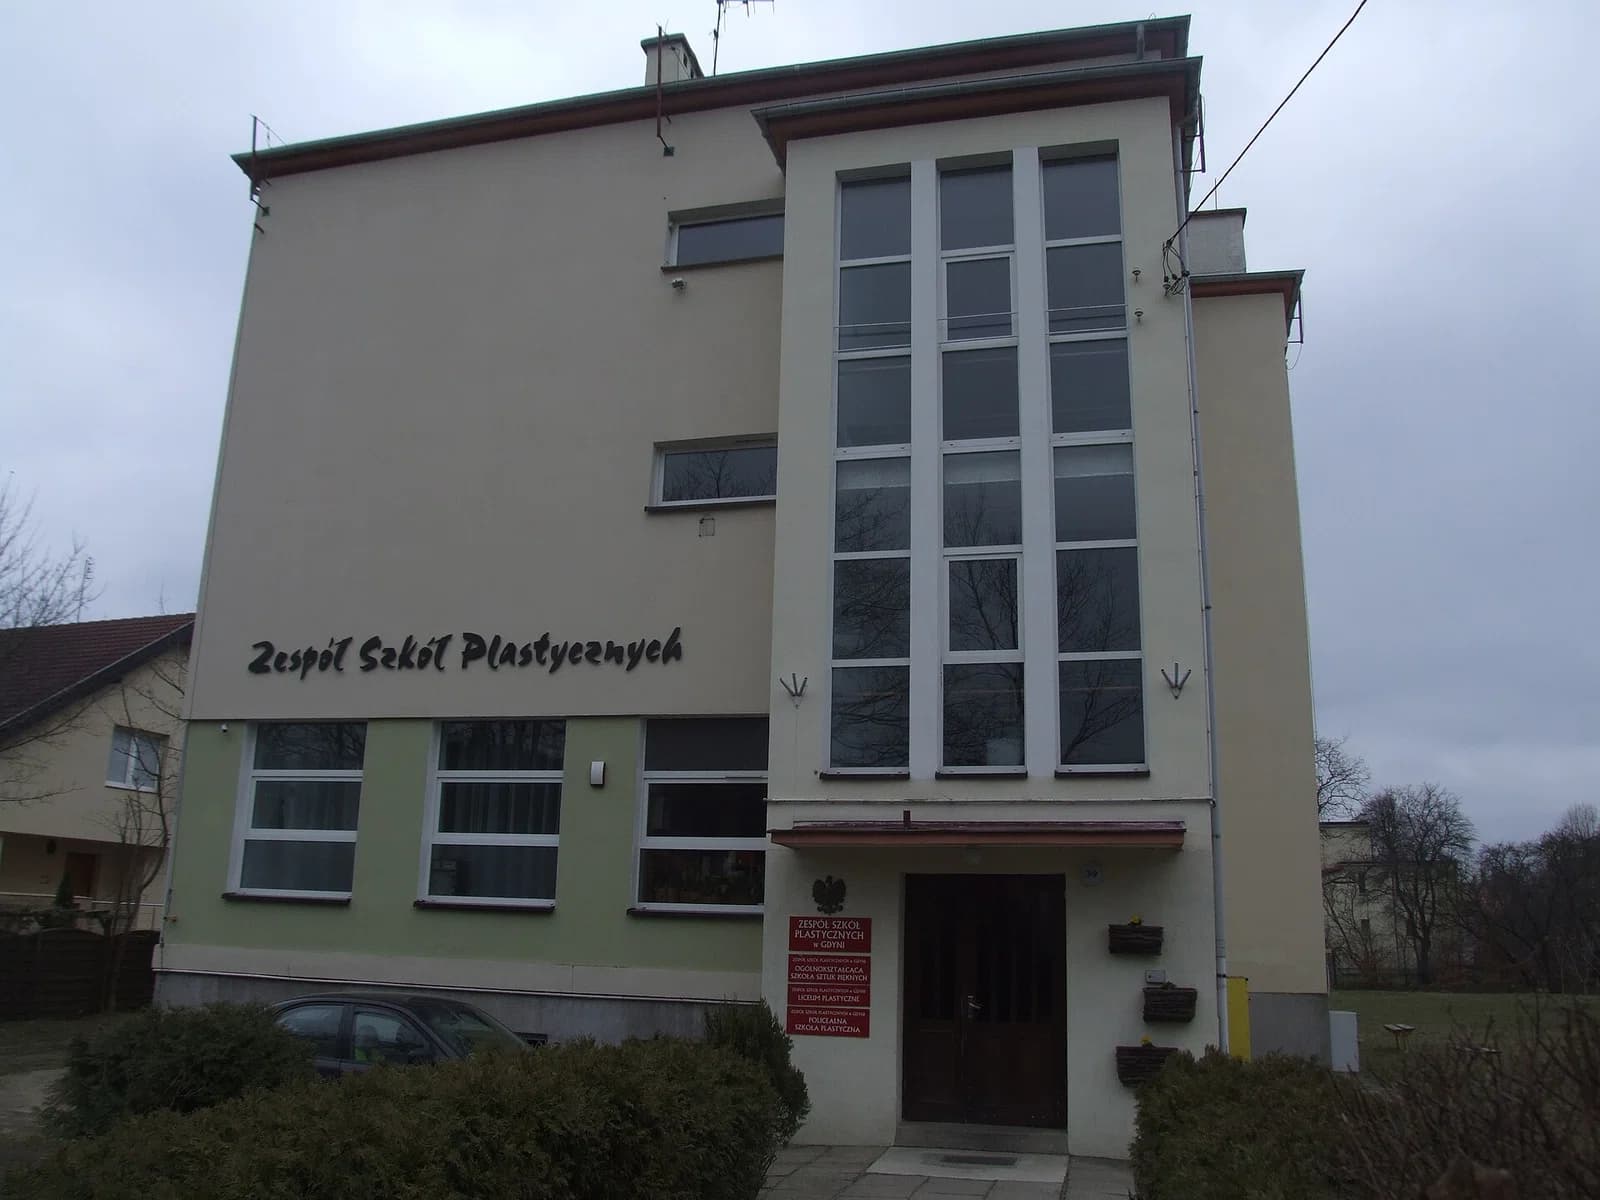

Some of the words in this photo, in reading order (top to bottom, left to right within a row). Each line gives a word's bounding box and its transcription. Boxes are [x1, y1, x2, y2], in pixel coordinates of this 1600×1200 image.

[248, 636, 353, 681] Zespół
[360, 634, 453, 672] Szkół
[461, 626, 682, 674] Plastycznych
[794, 929, 864, 940] PLASTYCZNYCH
[821, 940, 845, 949] GDYNI
[816, 973, 837, 981] SZTUK
[808, 1016, 848, 1025] POLICEALNA
[820, 1024, 861, 1033] PLASTYCZNA
